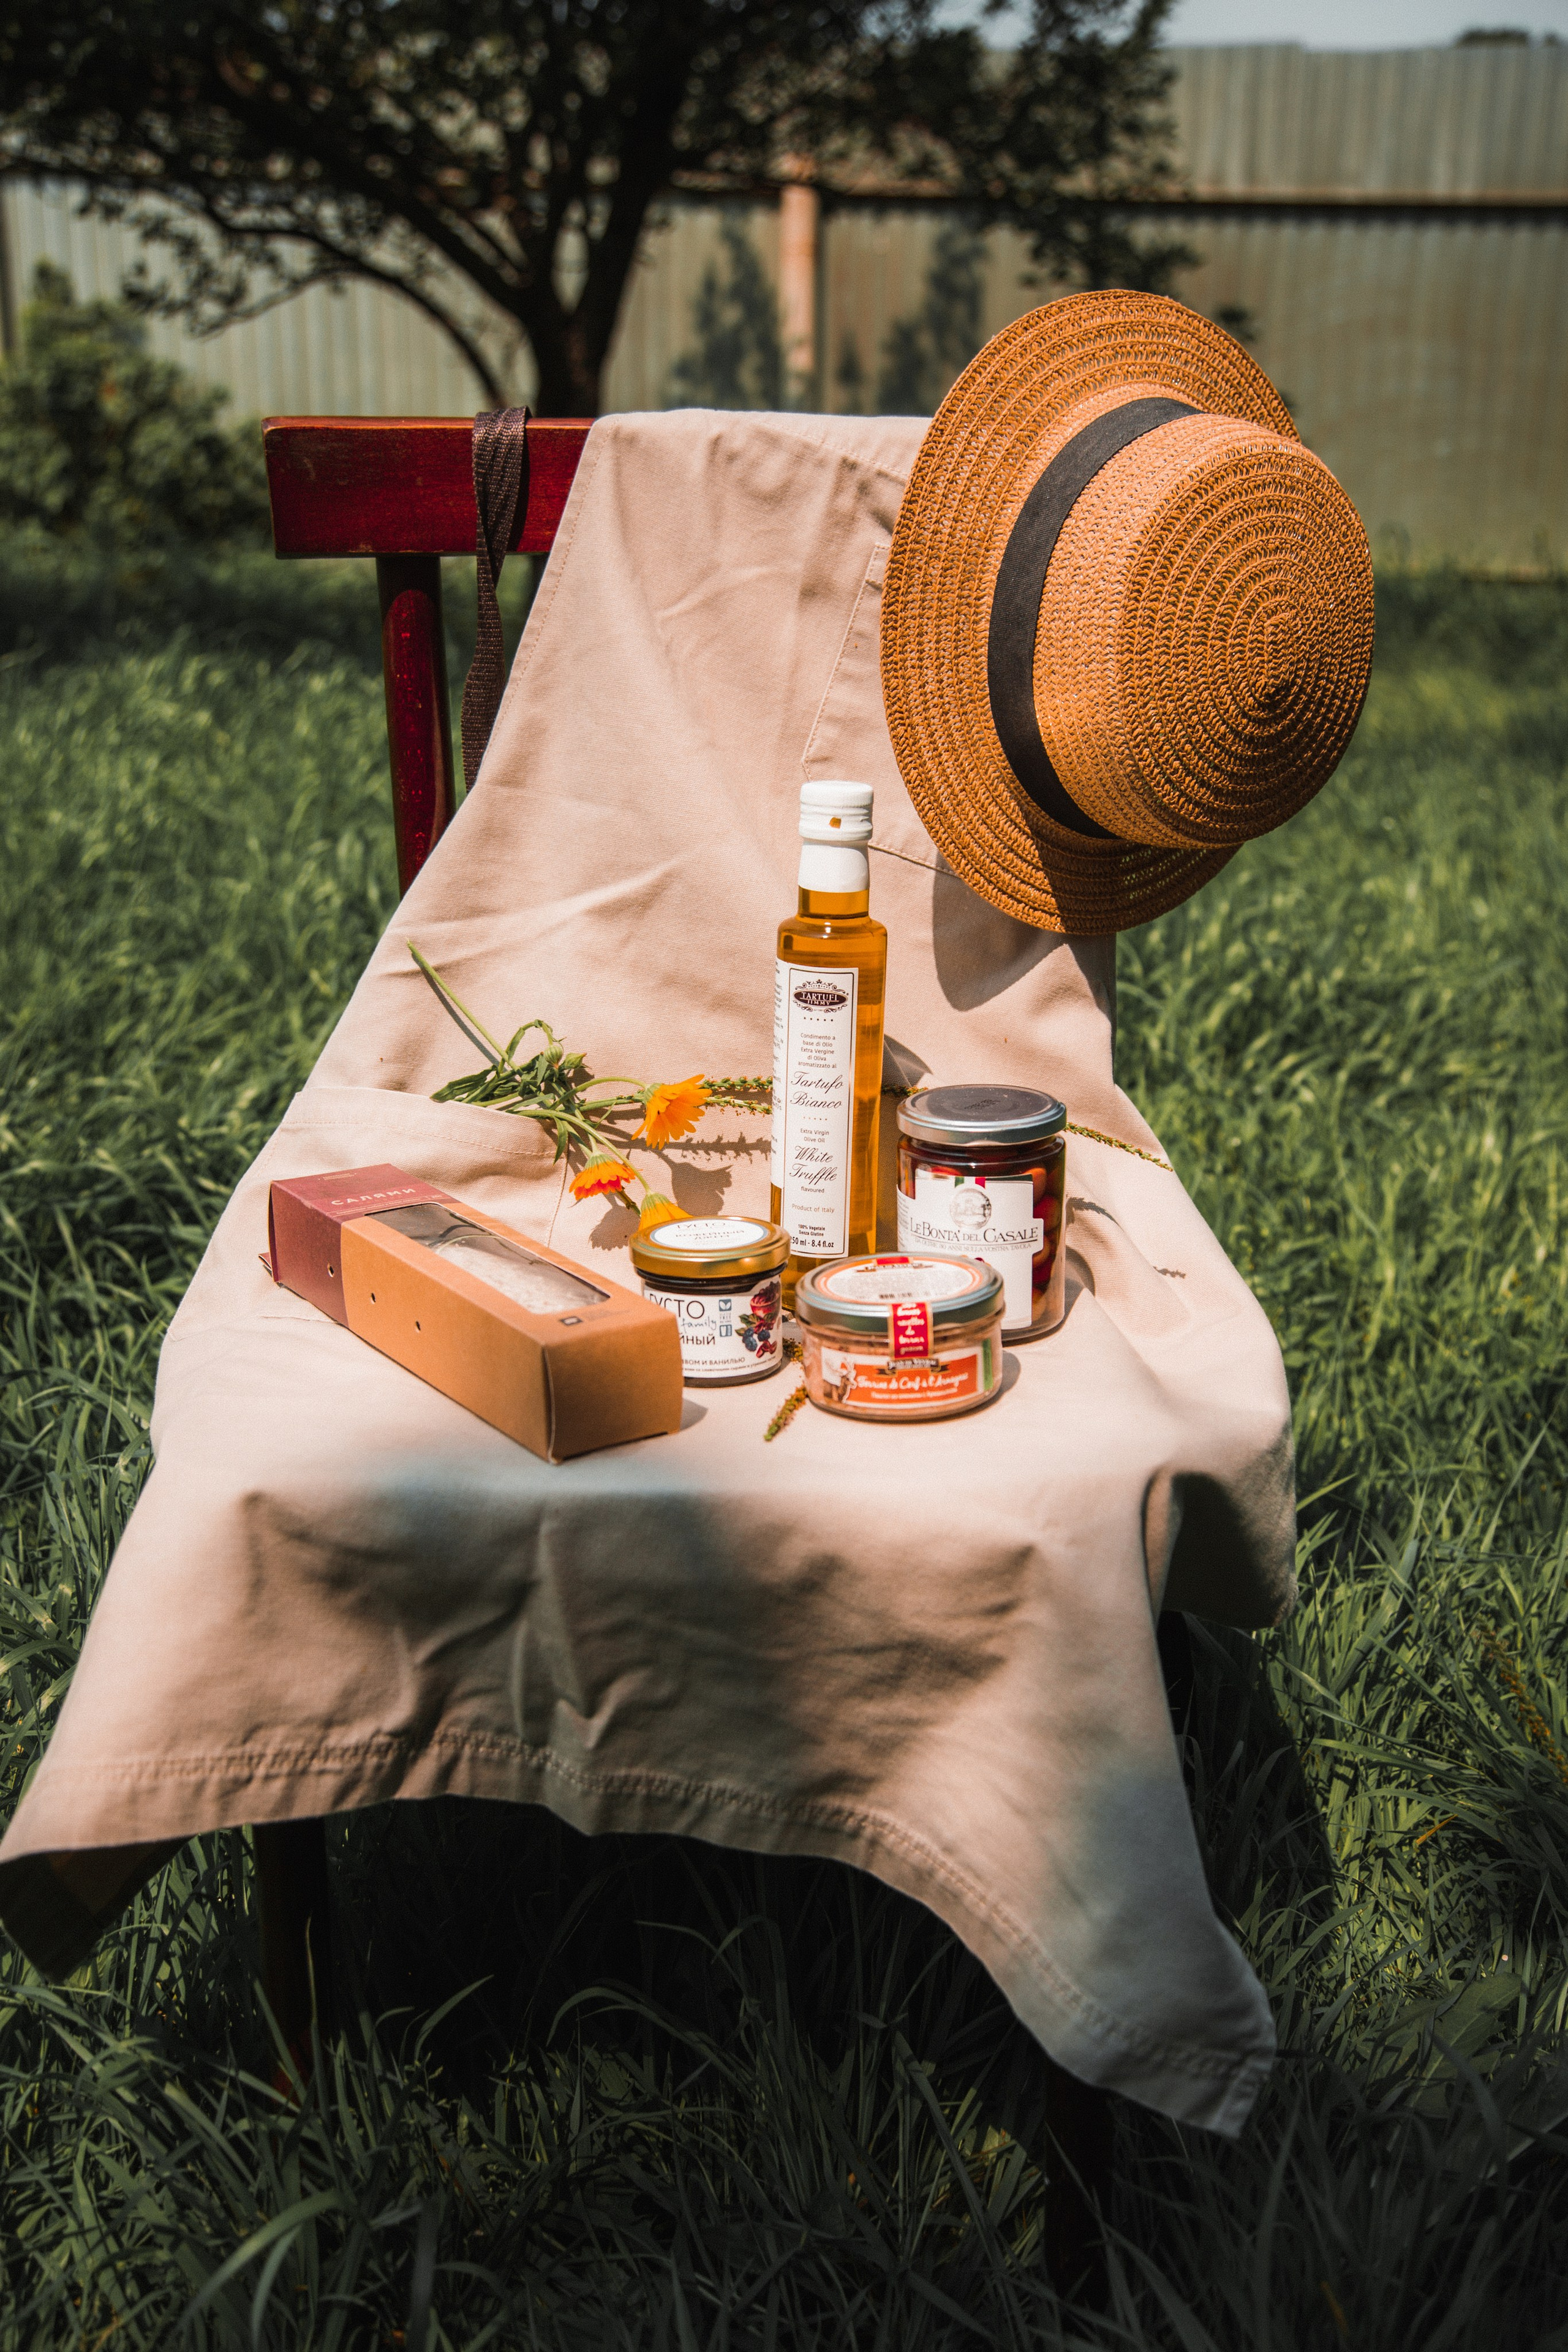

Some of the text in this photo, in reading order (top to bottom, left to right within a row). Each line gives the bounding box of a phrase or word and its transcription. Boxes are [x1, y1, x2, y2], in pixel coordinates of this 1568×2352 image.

[801, 992, 837, 1001] TARTUFI
[791, 1071, 843, 1094] Tartufo
[790, 1091, 842, 1109] Bianco
[794, 1145, 834, 1163] White
[790, 1163, 838, 1185] Truffle
[331, 1188, 417, 1206] САЛЯМИ
[791, 1204, 812, 1212] Product
[962, 1233, 981, 1242] DEL
[983, 1227, 1038, 1243] CASALE
[681, 1316, 717, 1333] family
[709, 1357, 745, 1366] ВАНИЛЬЮ
